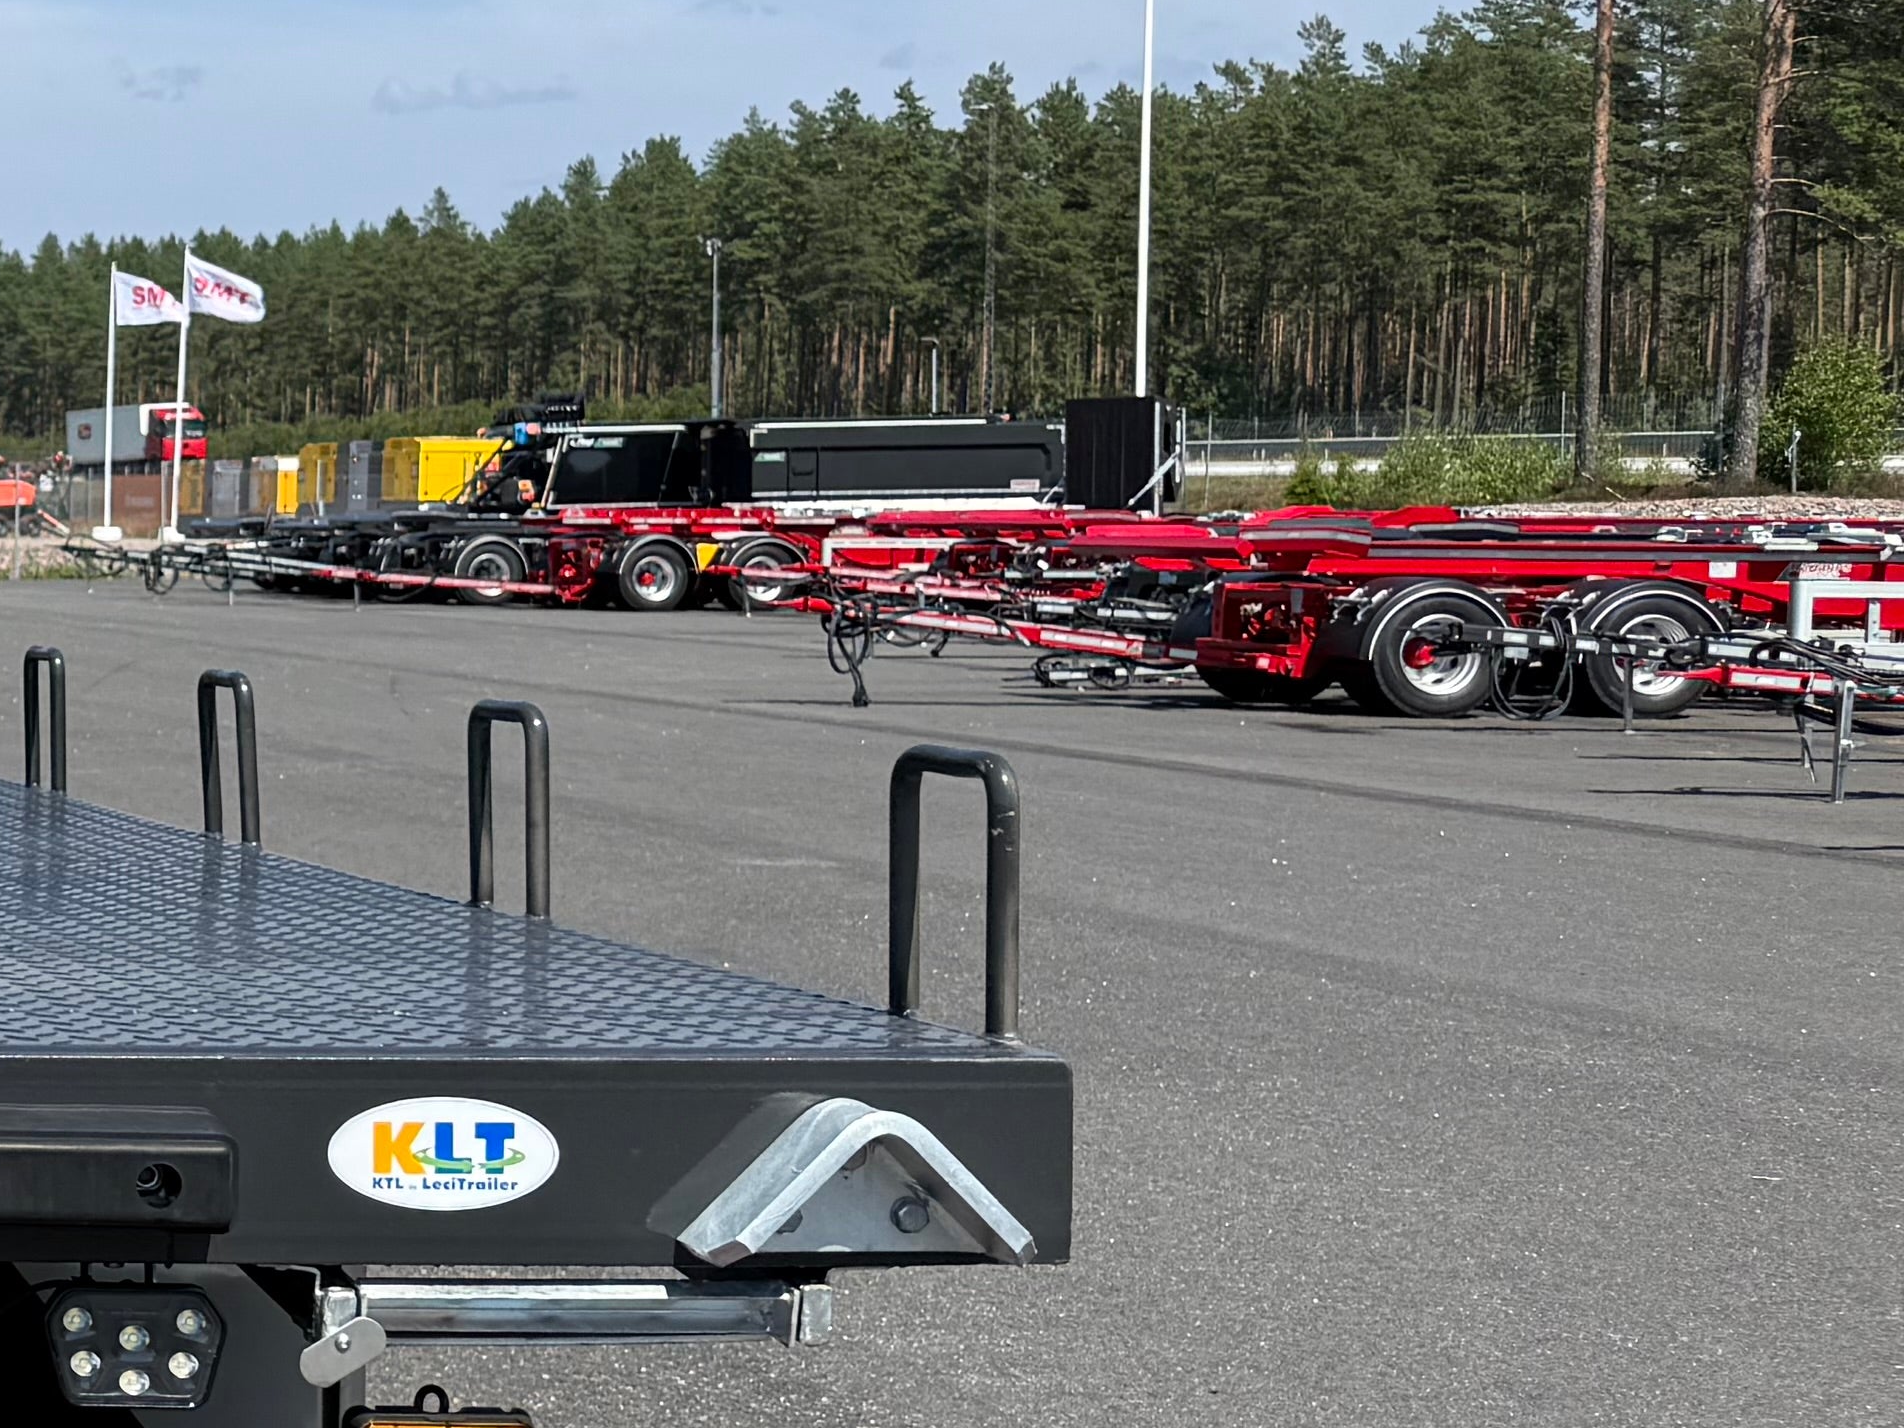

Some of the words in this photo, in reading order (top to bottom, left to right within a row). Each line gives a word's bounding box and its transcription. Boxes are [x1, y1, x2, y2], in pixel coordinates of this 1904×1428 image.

[373, 1122, 515, 1174] KLT
[372, 1177, 404, 1189] KTL
[422, 1177, 518, 1190] LeciTrailer
